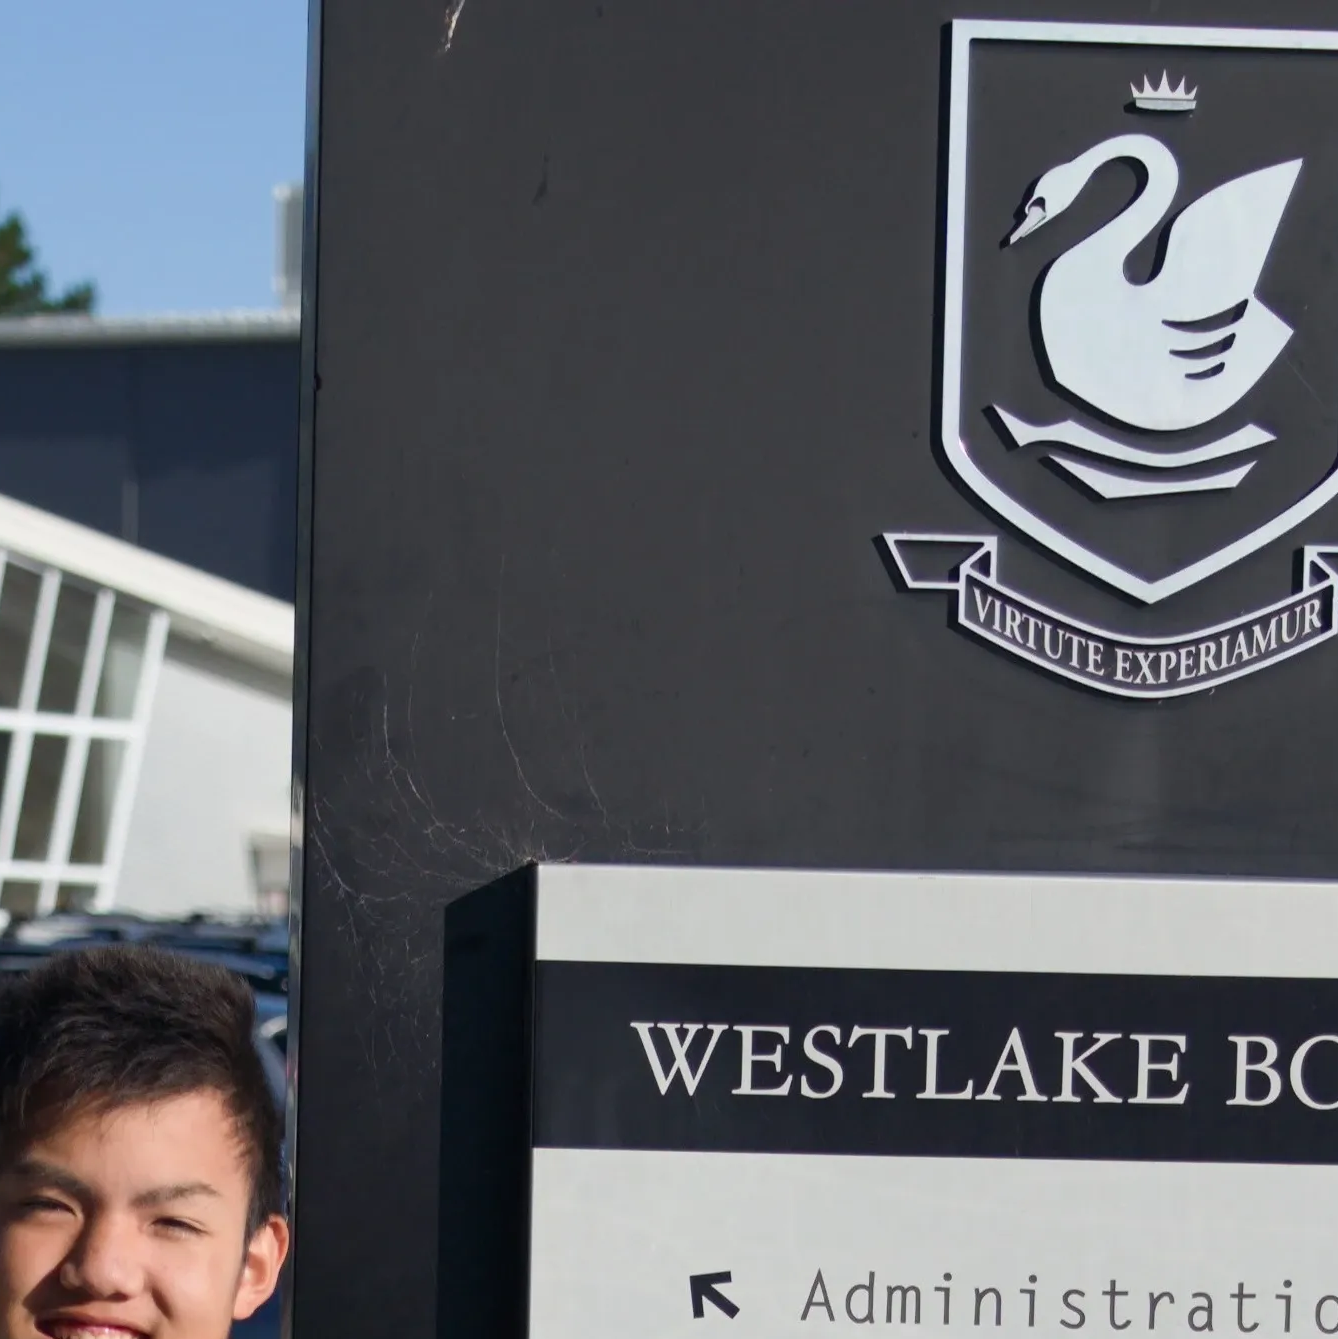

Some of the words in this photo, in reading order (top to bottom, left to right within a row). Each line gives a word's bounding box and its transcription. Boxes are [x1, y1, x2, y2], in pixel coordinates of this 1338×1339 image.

[972, 587, 1105, 676] VIRTUTE
[1114, 598, 1323, 685] EXPERIAMUR
[630, 1022, 1189, 1104] WESTLAKE
